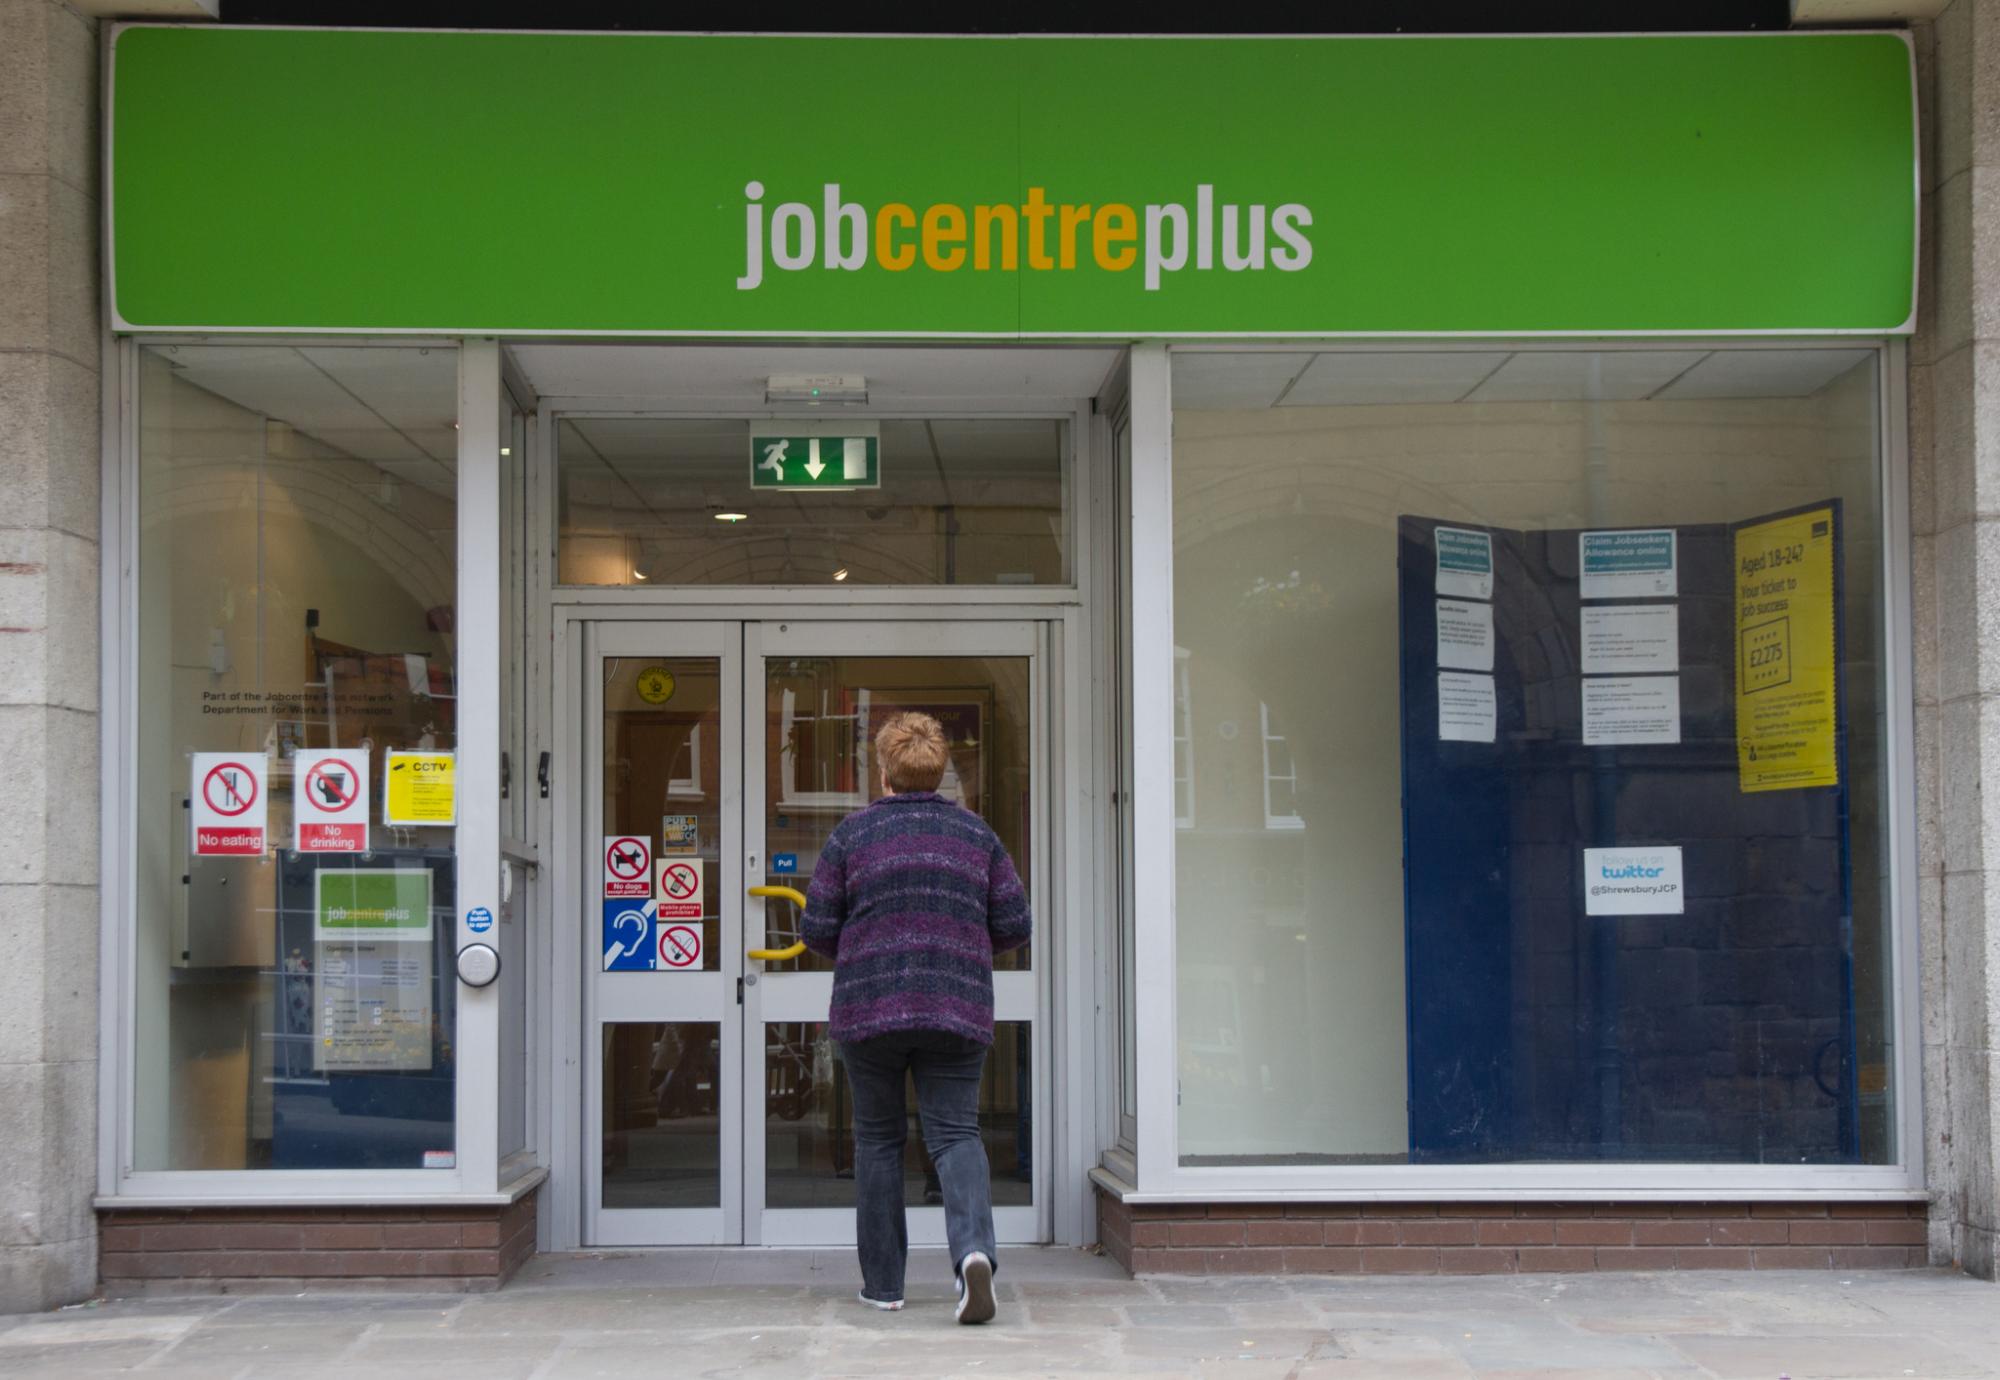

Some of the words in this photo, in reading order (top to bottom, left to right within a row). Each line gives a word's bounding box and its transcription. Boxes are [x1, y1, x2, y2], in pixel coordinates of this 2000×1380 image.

[736, 180, 1314, 291] jobcentreplus
[1584, 537, 1612, 546] Claim
[1615, 535, 1670, 545] Jobseekers
[1584, 548, 1634, 557] Allowance
[1636, 547, 1667, 555] online
[1741, 551, 1766, 577] Aged
[1768, 543, 1804, 568] 18-24?
[1741, 584, 1761, 599] Your
[1761, 578, 1785, 596] ticket
[1787, 577, 1797, 590] to
[1741, 601, 1755, 621] job
[1757, 598, 1789, 615] success
[203, 692, 226, 701] Part
[230, 692, 240, 701] of
[245, 692, 261, 701] the
[266, 692, 319, 701] Jobcentre
[203, 705, 267, 716] Department
[271, 705, 286, 714] for
[289, 705, 316, 714] Work
[413, 762, 447, 772] CCTV
[324, 825, 342, 836] No
[200, 834, 219, 846] No
[222, 834, 261, 849] eating
[311, 837, 355, 850] drinking
[778, 859, 793, 867] Pull
[1602, 865, 1664, 879] twitter
[625, 883, 642, 891] dogs
[1591, 884, 1677, 896] @ShrewsburyJCP
[327, 906, 411, 922] jobcentreplus
[649, 959, 655, 969] T
